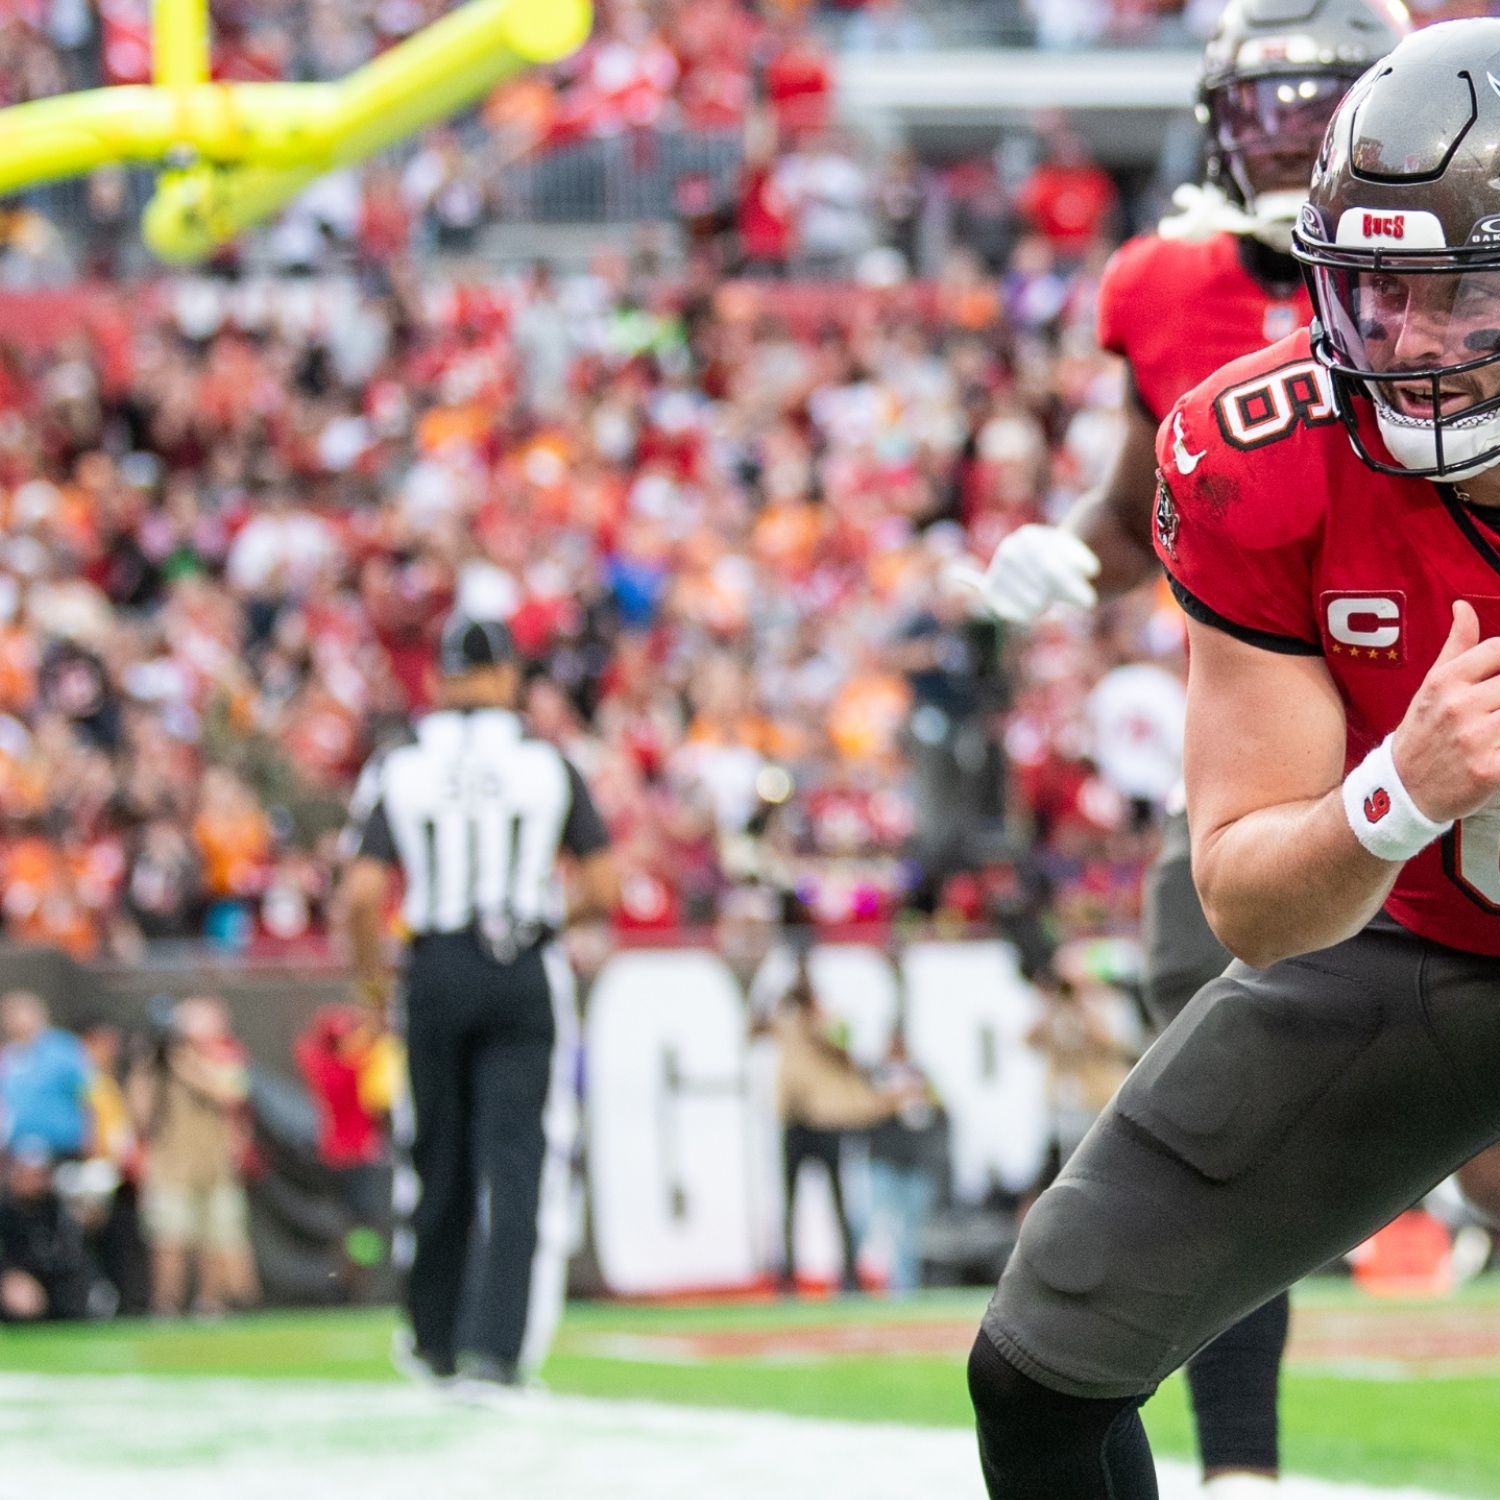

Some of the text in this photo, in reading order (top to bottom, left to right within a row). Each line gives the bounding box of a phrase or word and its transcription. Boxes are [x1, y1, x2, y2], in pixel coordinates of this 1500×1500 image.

[1362, 213, 1404, 239] BUCS
[1214, 357, 1334, 452] 6
[1327, 597, 1400, 648] C
